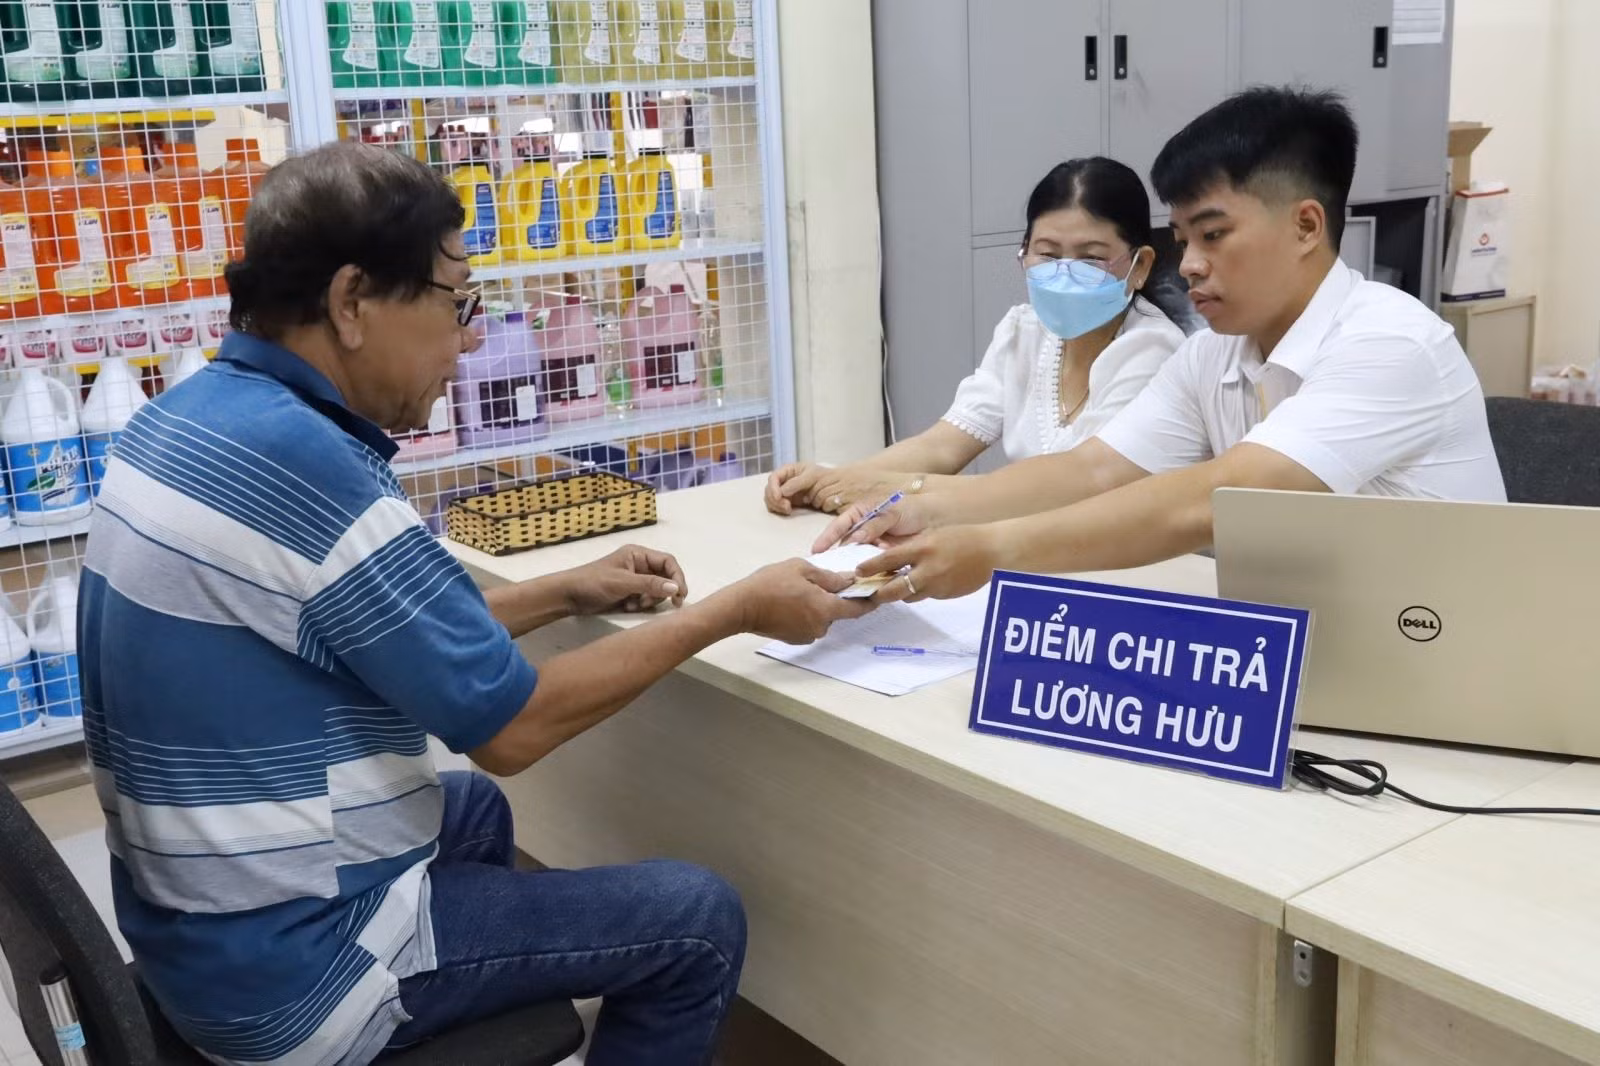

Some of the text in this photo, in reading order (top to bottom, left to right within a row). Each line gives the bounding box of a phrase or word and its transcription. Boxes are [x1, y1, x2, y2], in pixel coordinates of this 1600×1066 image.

[1004, 603, 1268, 692] ĐIỂM CHI TRẢ
[1402, 618, 1437, 629] DELL
[1010, 678, 1243, 753] LƯƠNG HƯU
